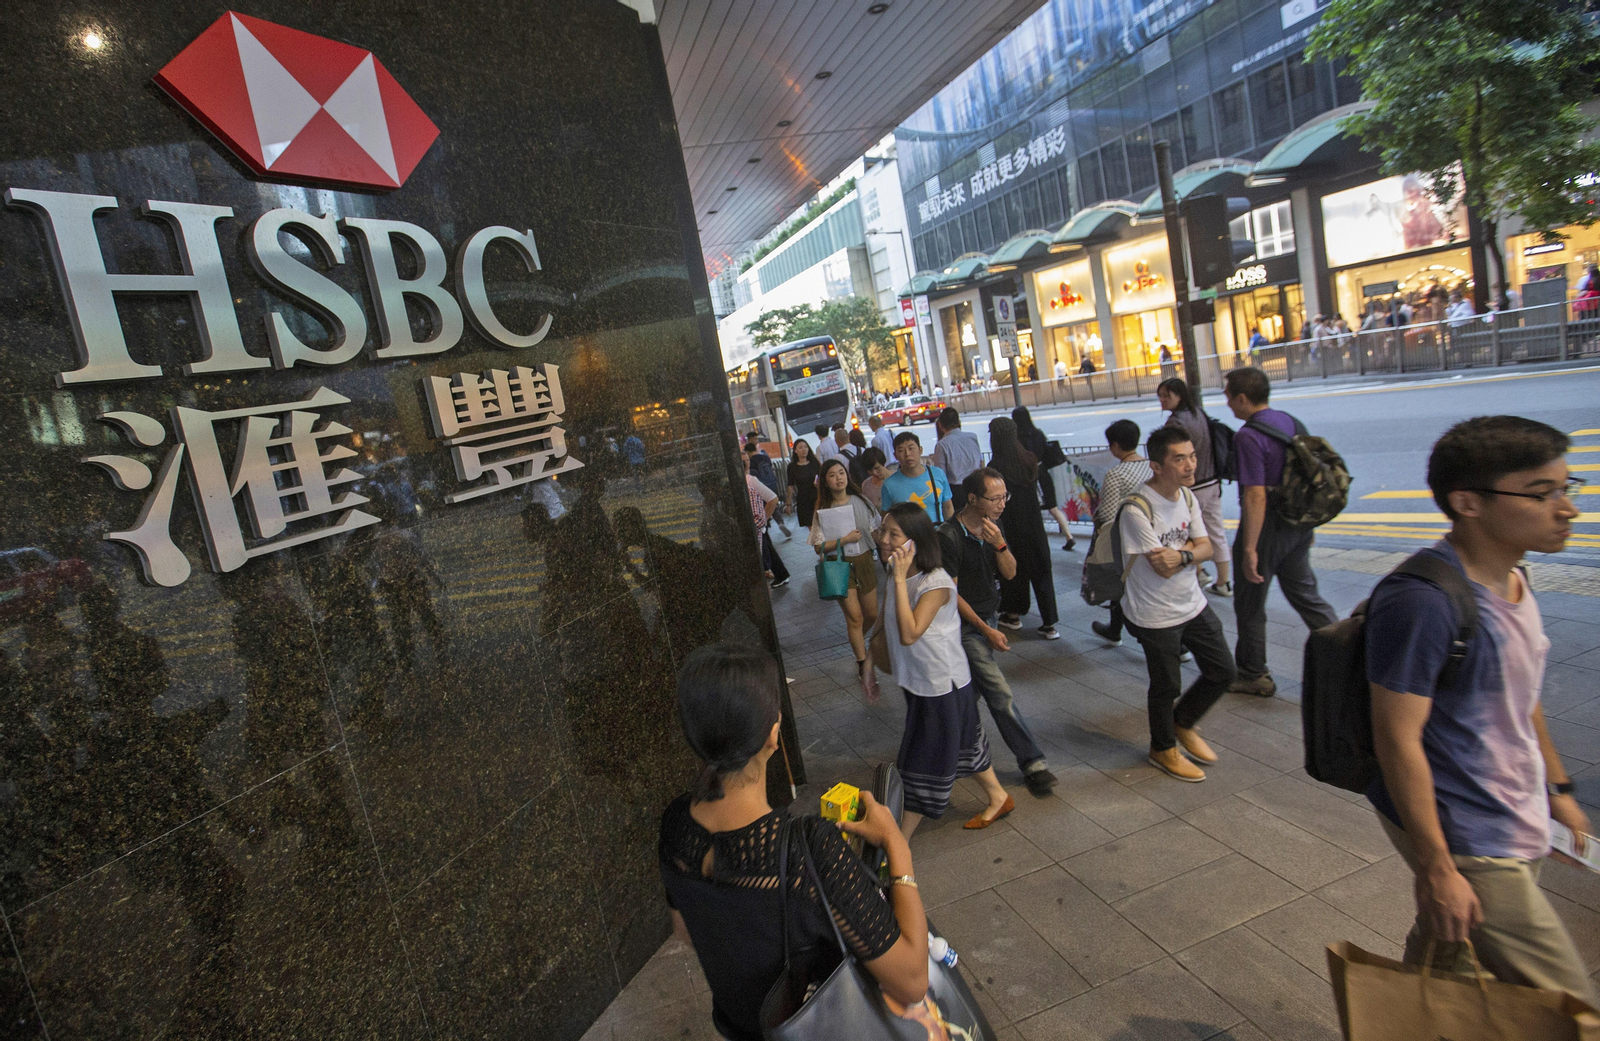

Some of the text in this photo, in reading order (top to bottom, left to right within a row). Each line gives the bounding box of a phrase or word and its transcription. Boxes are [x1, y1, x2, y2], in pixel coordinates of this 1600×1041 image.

[970, 125, 1066, 199] 成就更多精彩
[5, 187, 553, 387] HSBC
[1000, 327, 1008, 337] 24
[802, 366, 812, 378] 15
